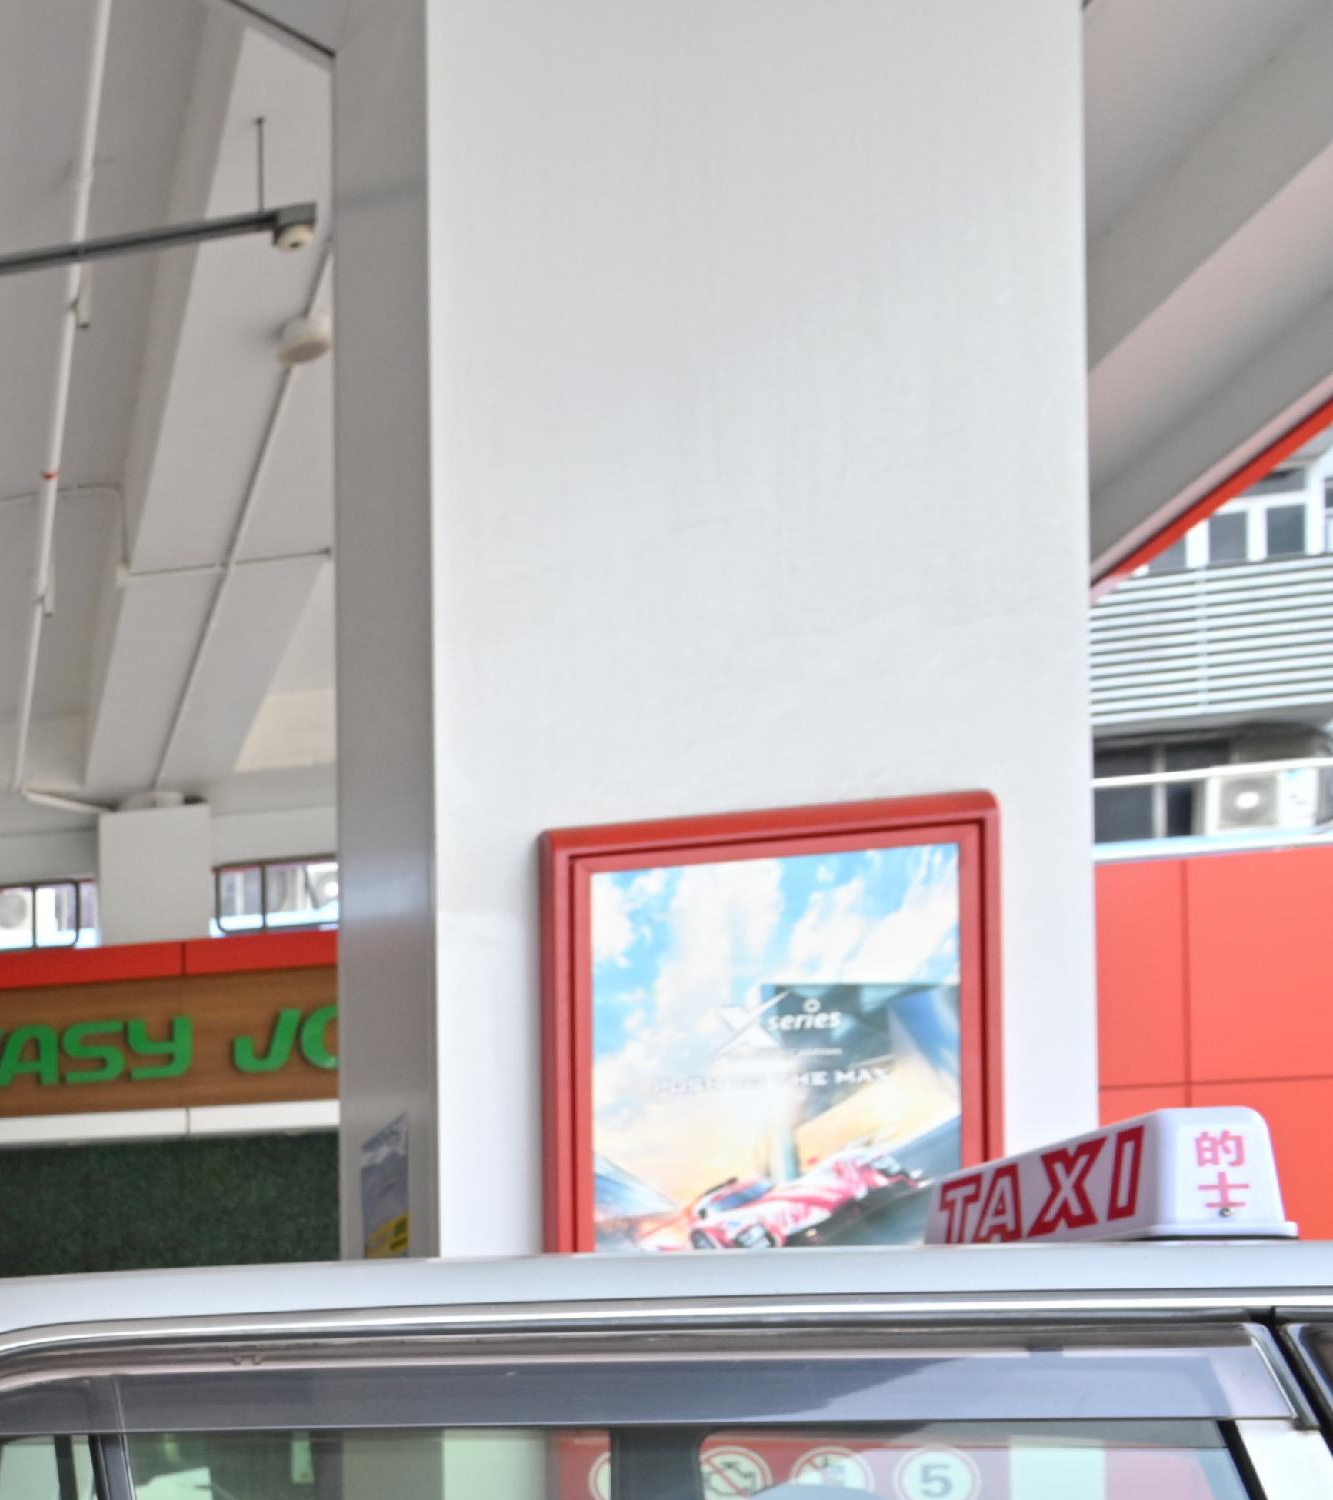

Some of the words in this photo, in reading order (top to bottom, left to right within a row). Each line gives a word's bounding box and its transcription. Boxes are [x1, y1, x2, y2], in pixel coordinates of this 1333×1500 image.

[767, 998, 842, 1031] series
[940, 1125, 1144, 1244] TAXI
[1194, 1129, 1250, 1209] 的士
[919, 1462, 953, 1498] 5
